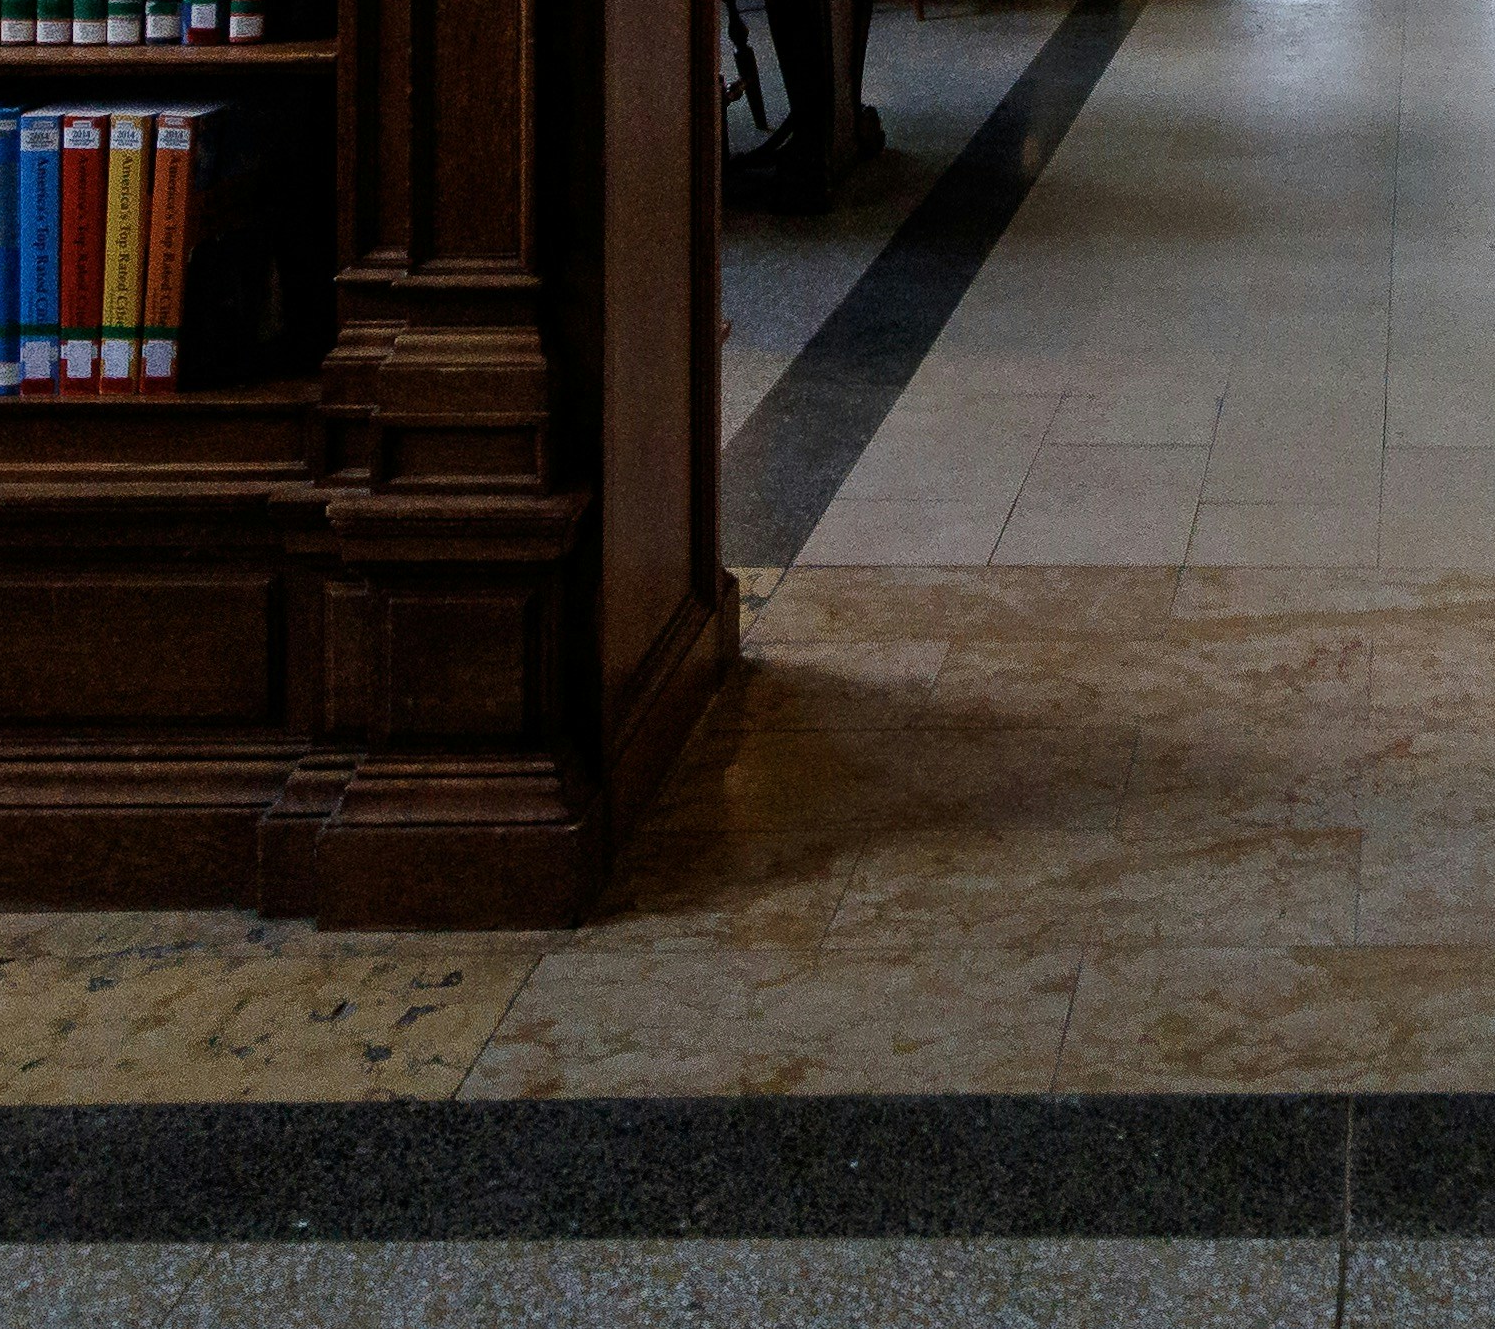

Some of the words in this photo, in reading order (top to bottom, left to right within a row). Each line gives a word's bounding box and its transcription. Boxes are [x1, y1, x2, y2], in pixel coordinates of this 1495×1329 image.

[33, 226, 49, 250] Top
[116, 224, 130, 248] Top
[36, 256, 48, 293] Rated
[117, 253, 130, 292] Rated
